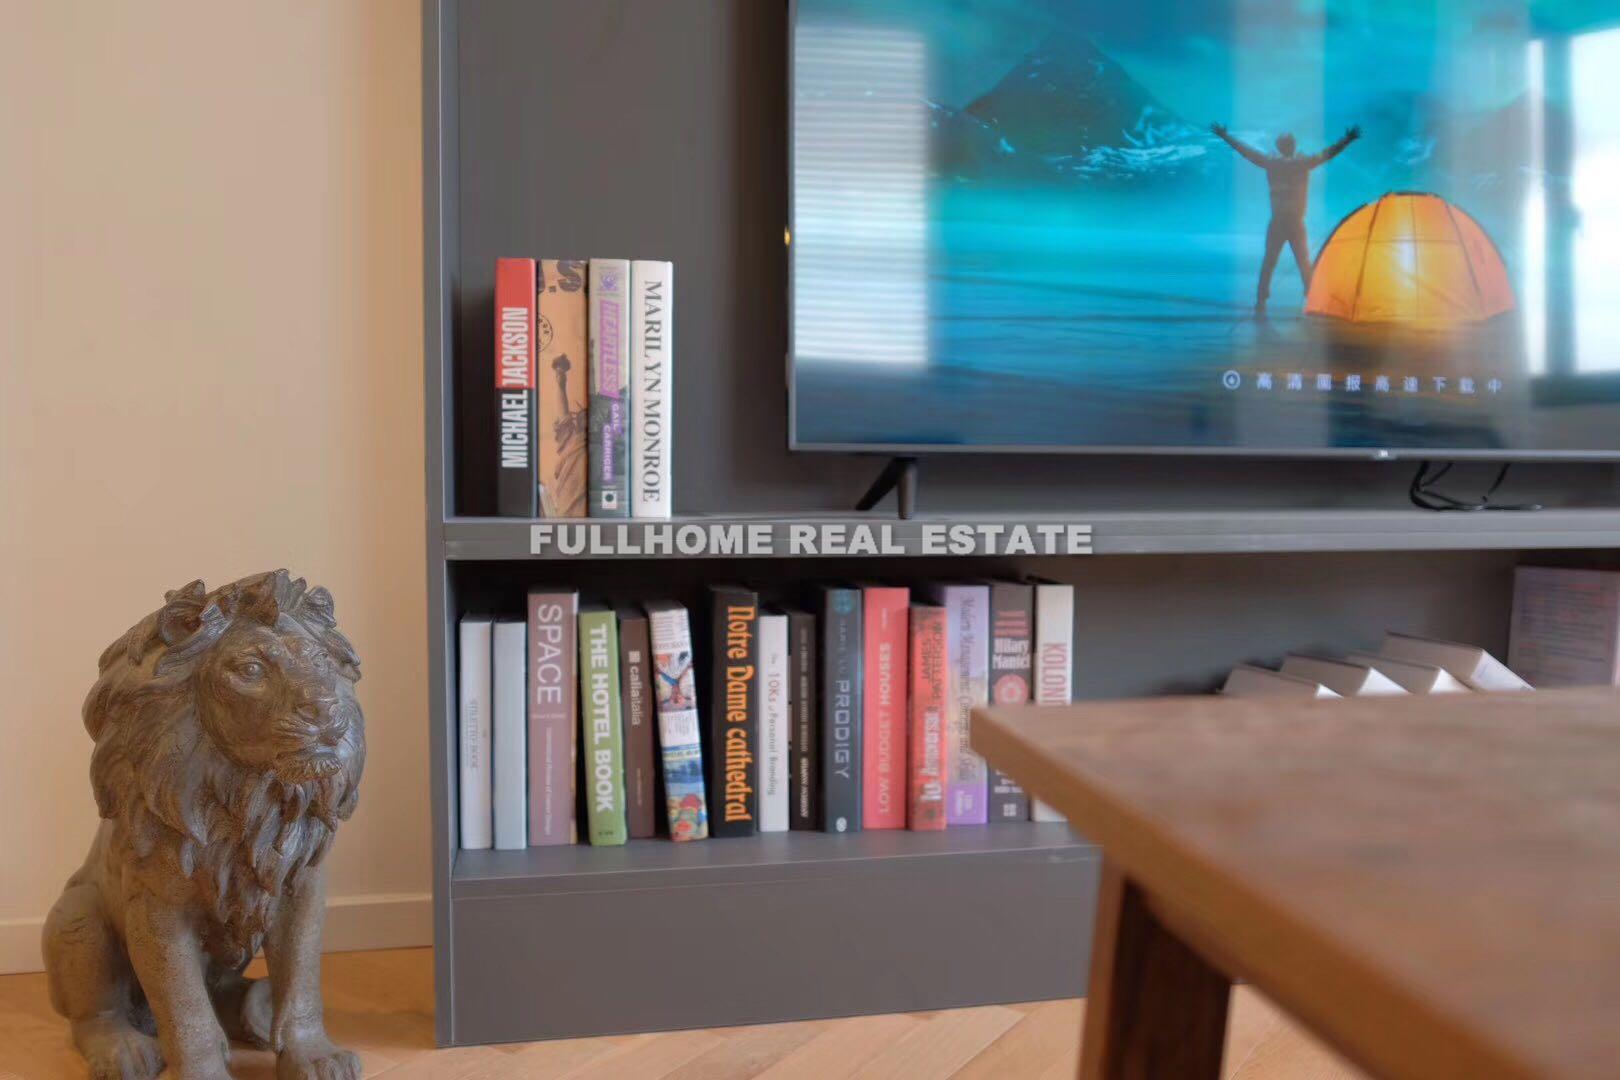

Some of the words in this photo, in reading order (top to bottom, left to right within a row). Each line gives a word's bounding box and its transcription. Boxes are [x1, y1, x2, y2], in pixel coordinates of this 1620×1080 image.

[501, 307, 528, 388] JACKSON
[644, 281, 662, 392] MARILYN
[501, 389, 528, 468] MICHAEL
[612, 403, 620, 430] GAIL
[642, 400, 661, 504] MONROE
[537, 604, 562, 705] SPACE
[590, 622, 608, 667] THE
[727, 605, 755, 660] Notre
[726, 665, 754, 722] Dame
[879, 642, 892, 706] HOUSES
[591, 673, 610, 745] HOTEL
[767, 712, 779, 752] Personal
[835, 680, 850, 779] PRODIGY
[879, 710, 891, 773] BUDGET
[595, 749, 614, 813] BOOK
[725, 728, 753, 821] cathedral
[766, 756, 778, 796] Branding
[879, 776, 891, 814] LOW
